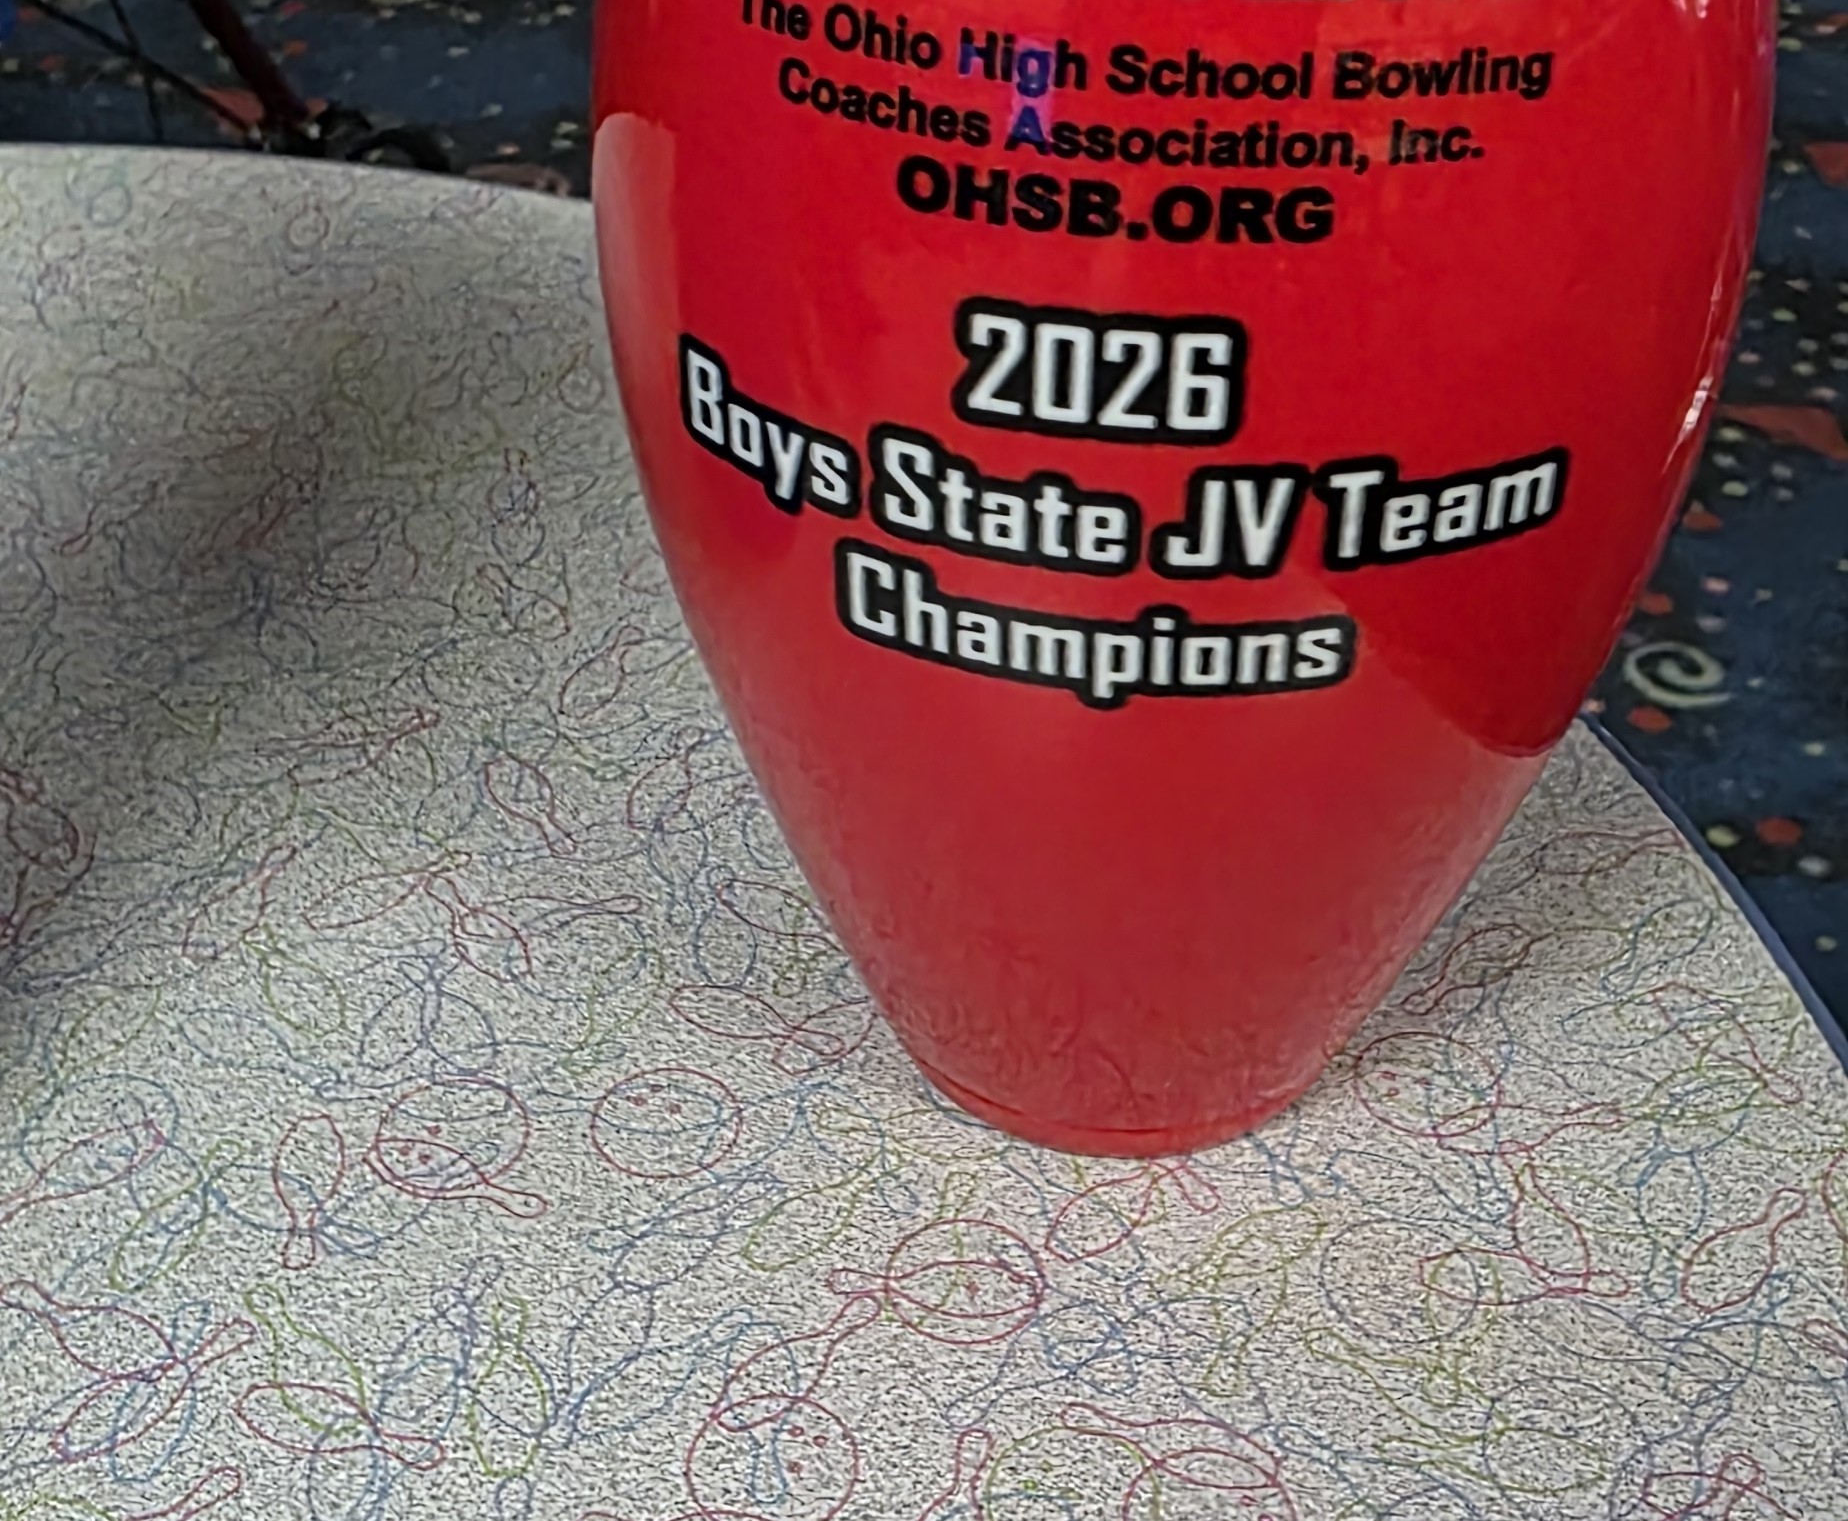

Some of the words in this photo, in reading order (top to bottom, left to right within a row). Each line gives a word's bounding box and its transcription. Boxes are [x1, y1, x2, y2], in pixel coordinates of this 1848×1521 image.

[823, 3, 942, 71] Ohio
[957, 26, 1088, 99] High
[1106, 43, 1314, 100] School
[1332, 45, 1554, 100] Bowling
[777, 56, 992, 148] Coaches
[1004, 104, 1370, 176] Association,
[1387, 118, 1486, 167] Inc.
[895, 154, 1336, 245] OHSB.ORG
[964, 309, 1235, 434] 2026
[685, 345, 853, 503] Boys
[880, 434, 1130, 566] State
[1163, 475, 1298, 570] JV
[1326, 459, 1561, 561] Team
[844, 548, 1345, 701] Champions
